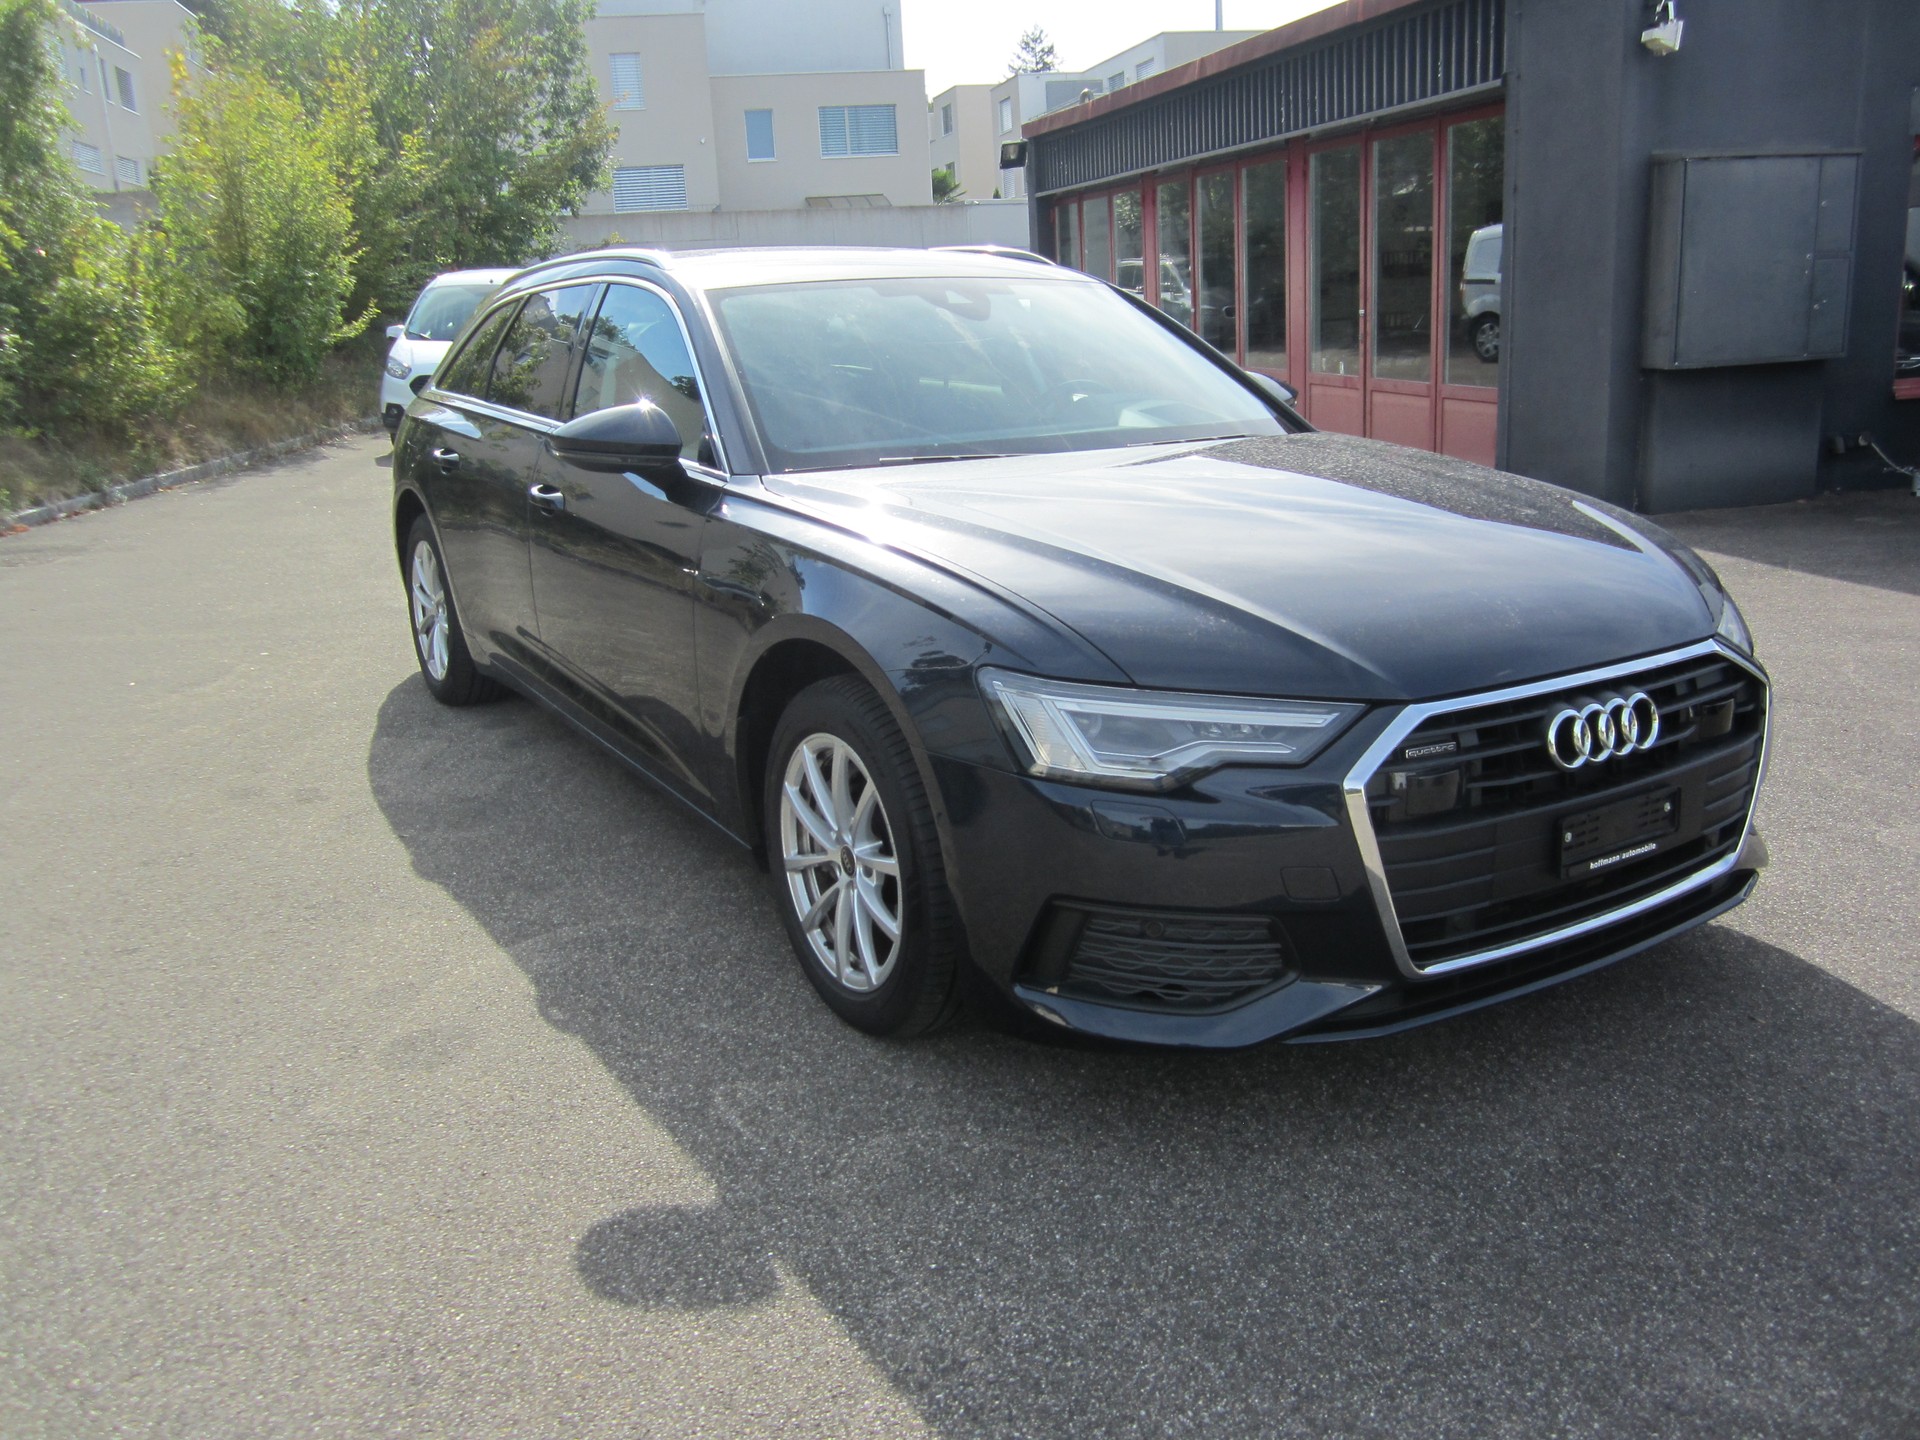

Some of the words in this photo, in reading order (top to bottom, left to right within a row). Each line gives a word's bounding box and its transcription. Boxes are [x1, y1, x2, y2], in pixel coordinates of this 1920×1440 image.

[1408, 744, 1455, 757] quattro
[1590, 855, 1620, 869] hoffmann
[1621, 843, 1656, 859] automobile
